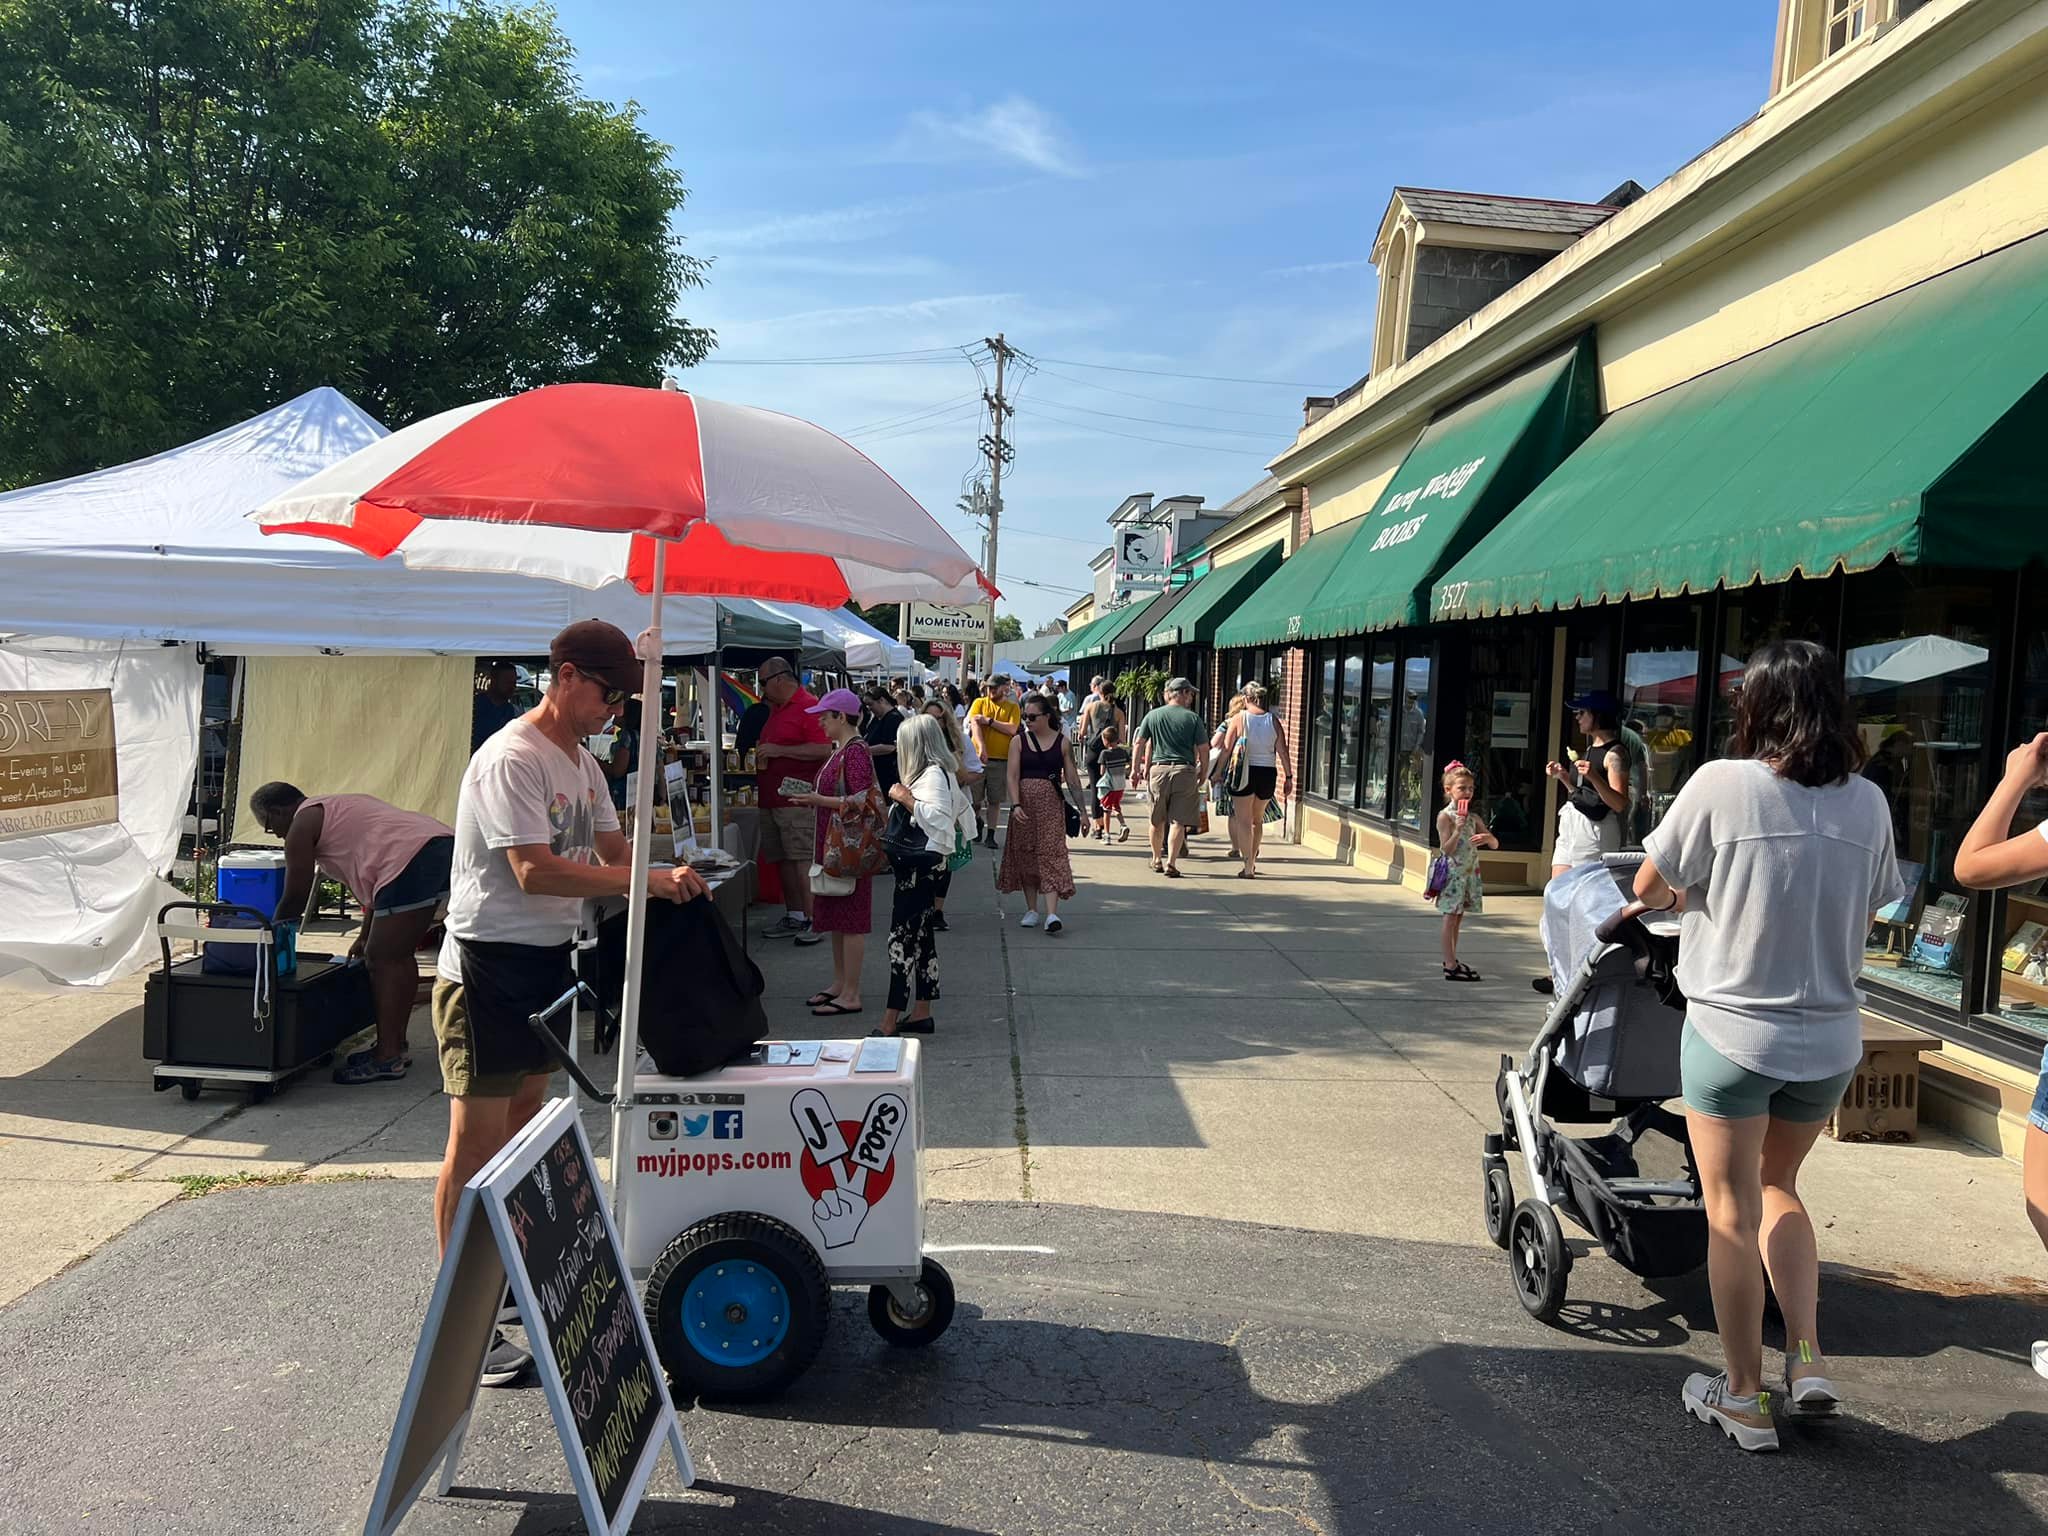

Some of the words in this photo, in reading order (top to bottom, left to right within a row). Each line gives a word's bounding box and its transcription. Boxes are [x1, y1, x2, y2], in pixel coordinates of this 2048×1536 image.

[1369, 513, 1429, 552] BOOKS
[1439, 581, 1469, 611] 3527
[914, 616, 985, 630] MOMENTUM
[10, 759, 47, 780] Evening
[51, 756, 64, 776] Tea
[66, 753, 86, 774] Loaf
[0, 787, 23, 803] weet
[25, 782, 62, 801] Artisan
[63, 778, 87, 798] Bread
[858, 1101, 899, 1164] POPS
[636, 1147, 792, 1178] myjpops.com
[557, 1237, 585, 1292] FRUIT
[580, 1264, 617, 1328] BASIL
